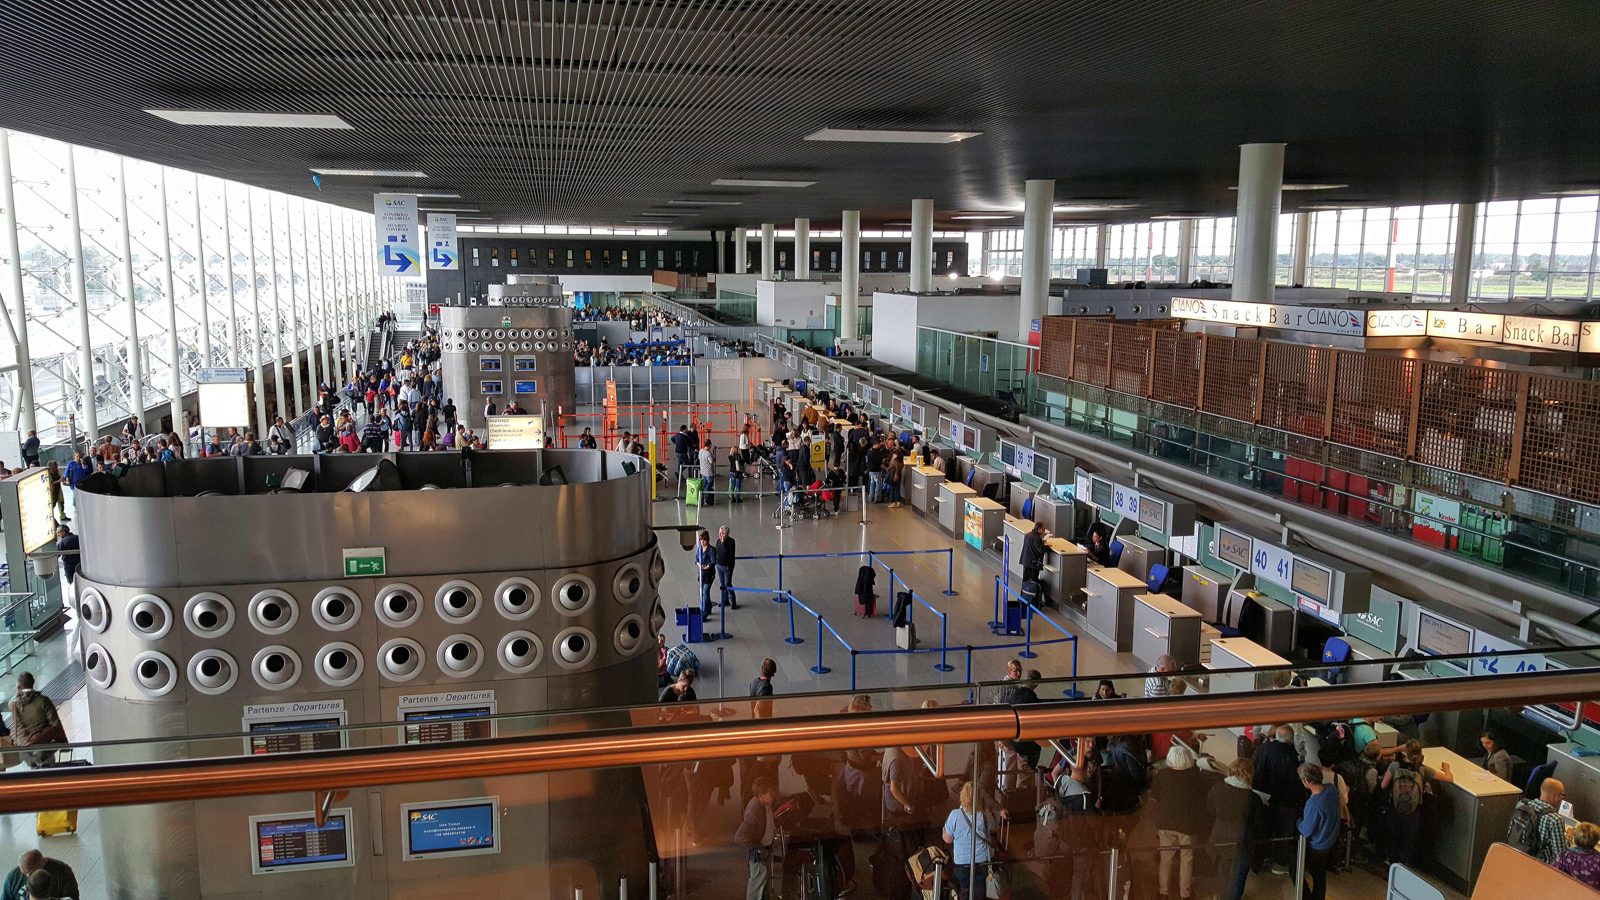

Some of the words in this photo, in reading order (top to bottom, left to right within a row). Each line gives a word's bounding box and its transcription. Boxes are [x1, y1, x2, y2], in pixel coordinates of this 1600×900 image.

[1172, 298, 1200, 314] CIANO
[1212, 303, 1262, 323] Snack
[1269, 307, 1302, 326] Bar
[1307, 308, 1349, 328] CIANO
[1458, 317, 1497, 336] Bar
[1504, 320, 1544, 343] Snack
[1551, 325, 1578, 347] Bar
[1115, 491, 1124, 507] 38
[1128, 496, 1138, 513] 39
[1148, 508, 1160, 521] SAC
[1231, 543, 1249, 558] SAC
[1255, 549, 1268, 570] 40
[1276, 558, 1289, 580] 41
[1366, 613, 1384, 628] SAC
[403, 695, 438, 704] Partenze
[446, 692, 491, 703] Departures
[247, 706, 285, 714] Partenze
[292, 702, 340, 713] Departures
[422, 813, 438, 821] SAC
